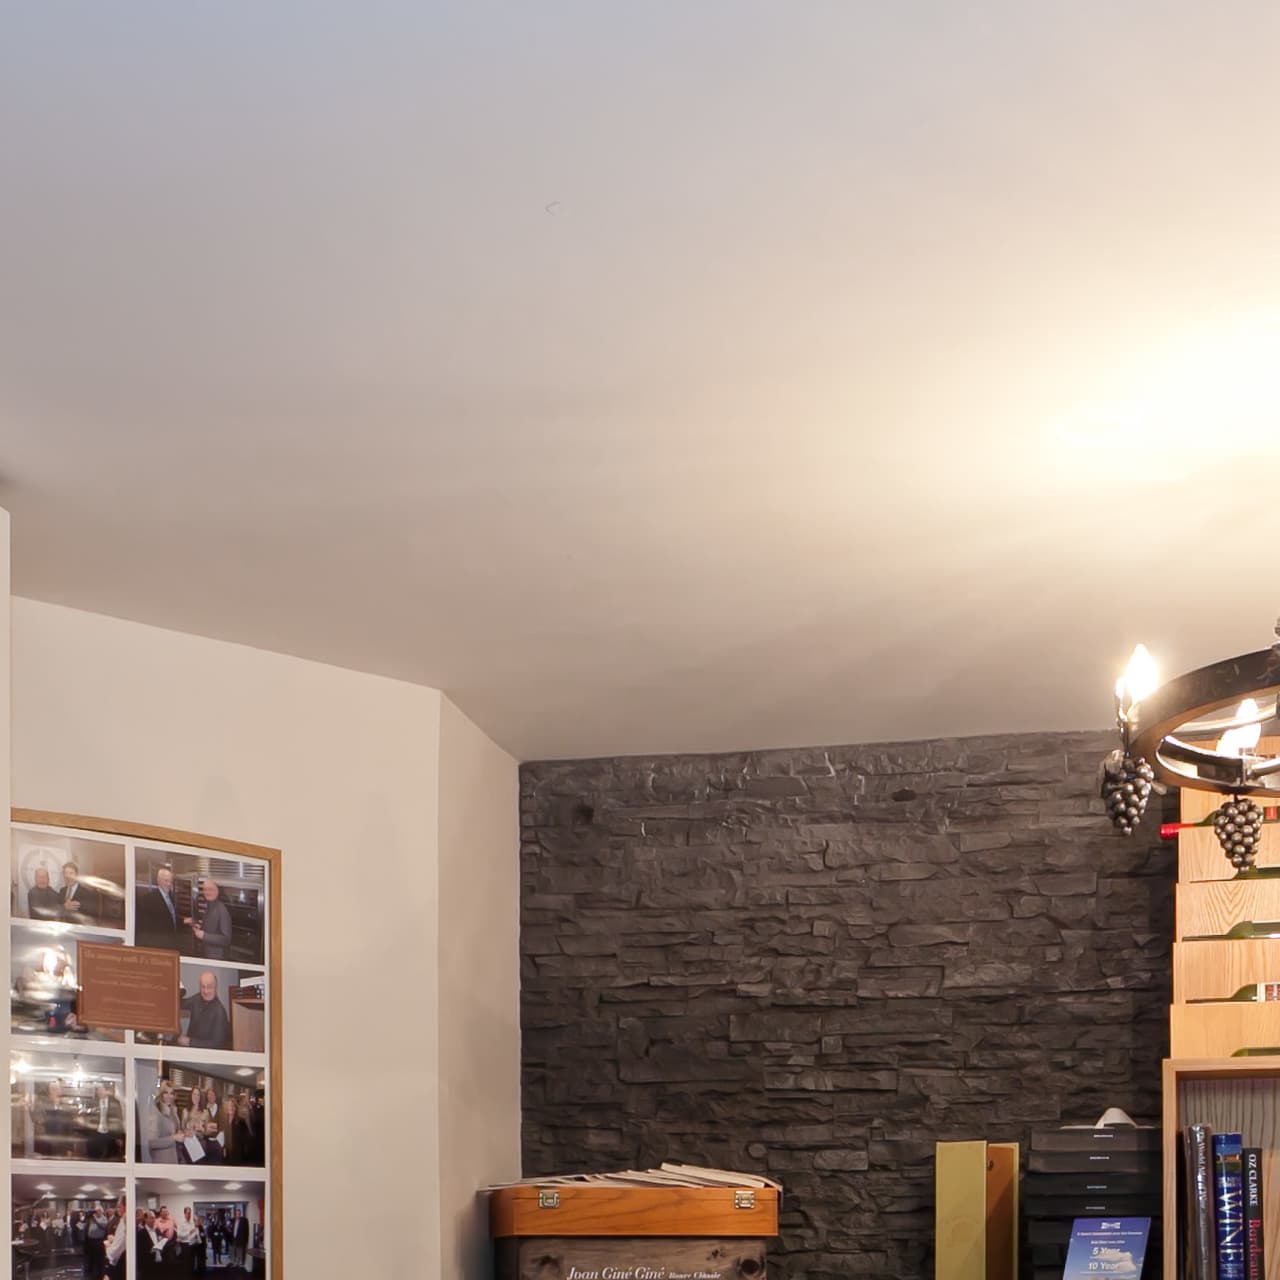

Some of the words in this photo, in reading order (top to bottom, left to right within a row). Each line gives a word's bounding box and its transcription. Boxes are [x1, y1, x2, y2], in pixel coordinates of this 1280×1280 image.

[1248, 1153, 1257, 1168] OZ
[1248, 1169, 1259, 1206] CLARKE
[1219, 1189, 1243, 1262] WINE
[567, 1267, 598, 1280] Joan
[601, 1267, 632, 1280] Giné
[634, 1266, 665, 1280] Giné
